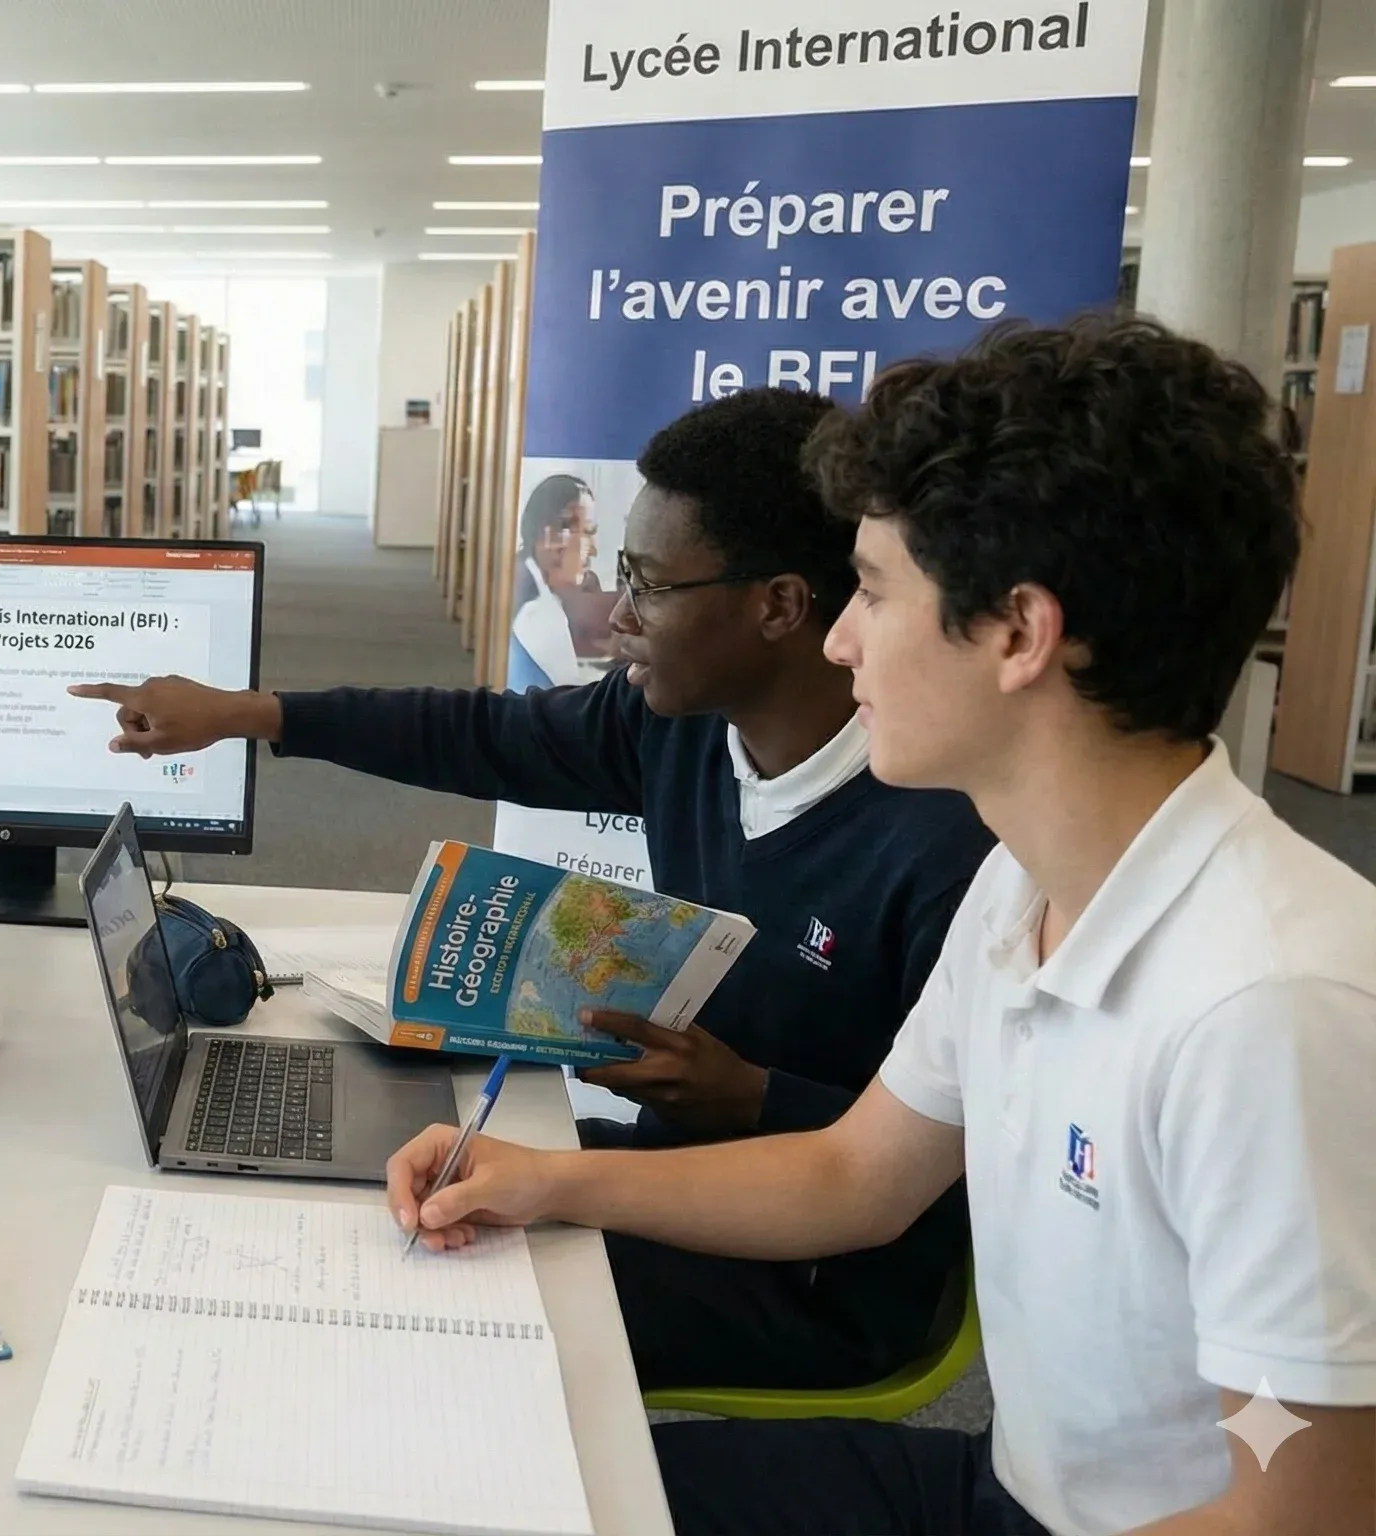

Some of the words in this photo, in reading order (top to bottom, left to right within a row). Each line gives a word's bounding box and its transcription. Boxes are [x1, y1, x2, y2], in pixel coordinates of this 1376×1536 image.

[583, 32, 721, 91] Lycée
[738, 1, 1090, 72] International
[659, 180, 950, 249] Préparer
[589, 265, 824, 320] l’avenir
[841, 274, 1007, 320] avec
[691, 349, 744, 401] le
[767, 349, 877, 404] BFI
[16, 609, 124, 628] International
[130, 611, 169, 632] (BFI)
[54, 633, 95, 650] 2026
[556, 851, 646, 883] Préparer
[427, 894, 477, 990] Histoire-
[455, 875, 520, 1007] Géographie
